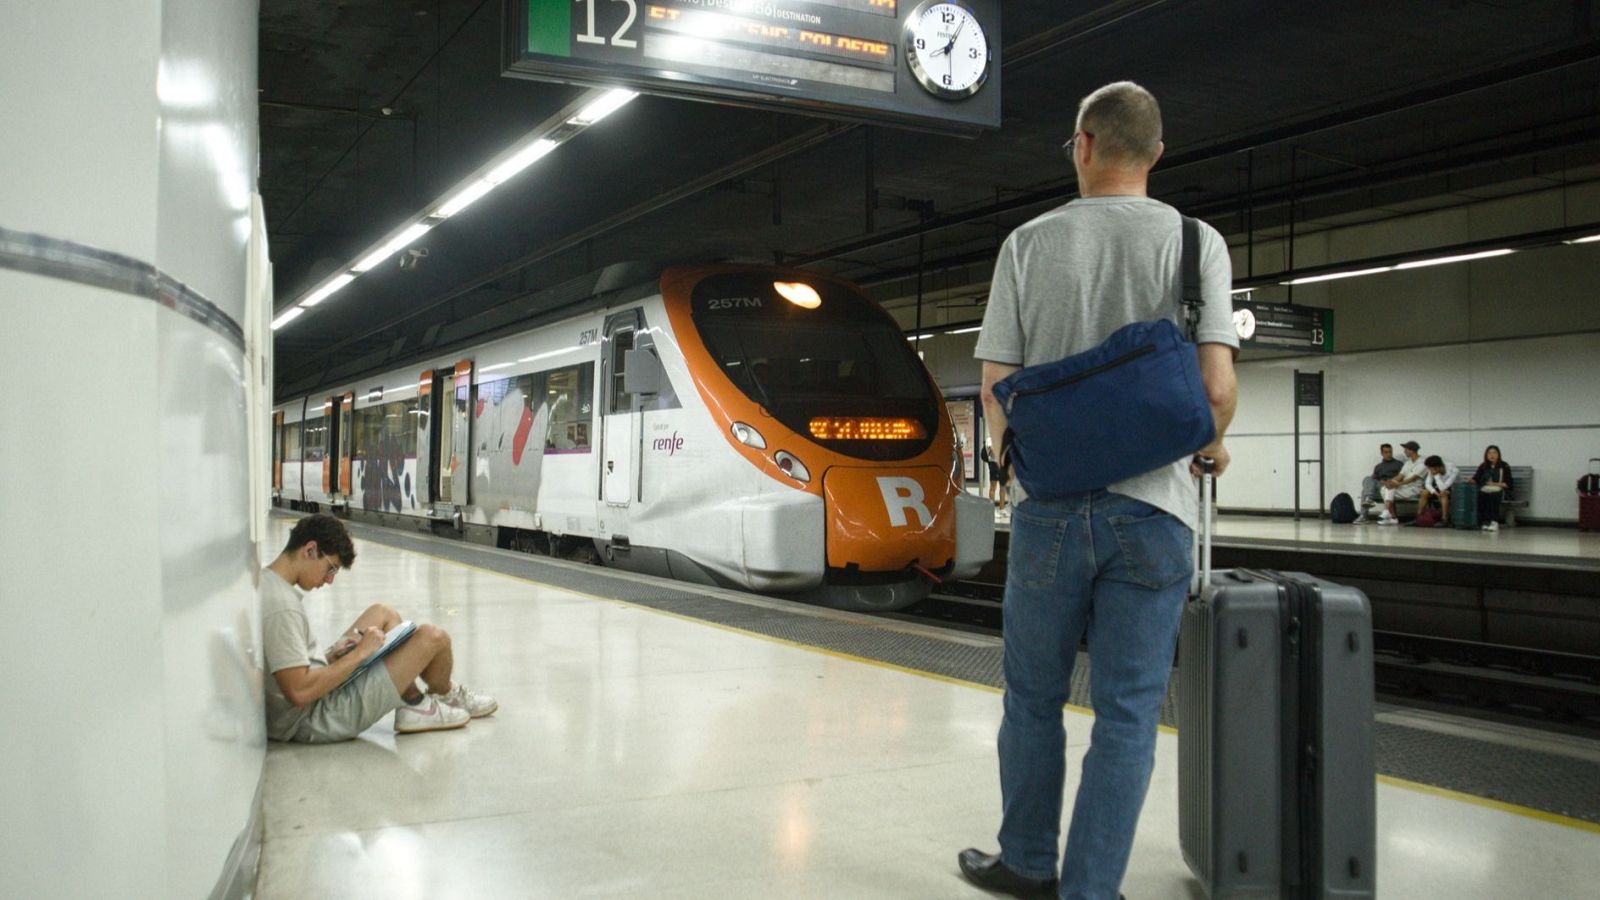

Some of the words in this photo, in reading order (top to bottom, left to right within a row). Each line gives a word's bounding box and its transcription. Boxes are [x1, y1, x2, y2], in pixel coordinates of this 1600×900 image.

[576, 0, 638, 48] 12
[941, 12, 955, 23] 12
[916, 38, 926, 50] 9
[969, 48, 978, 59] 3
[942, 74, 952, 85] 6
[708, 297, 762, 309] 257M
[579, 327, 598, 346] 257M
[1311, 328, 1324, 345] 13
[653, 430, 684, 456] renfe
[876, 476, 934, 527] R
